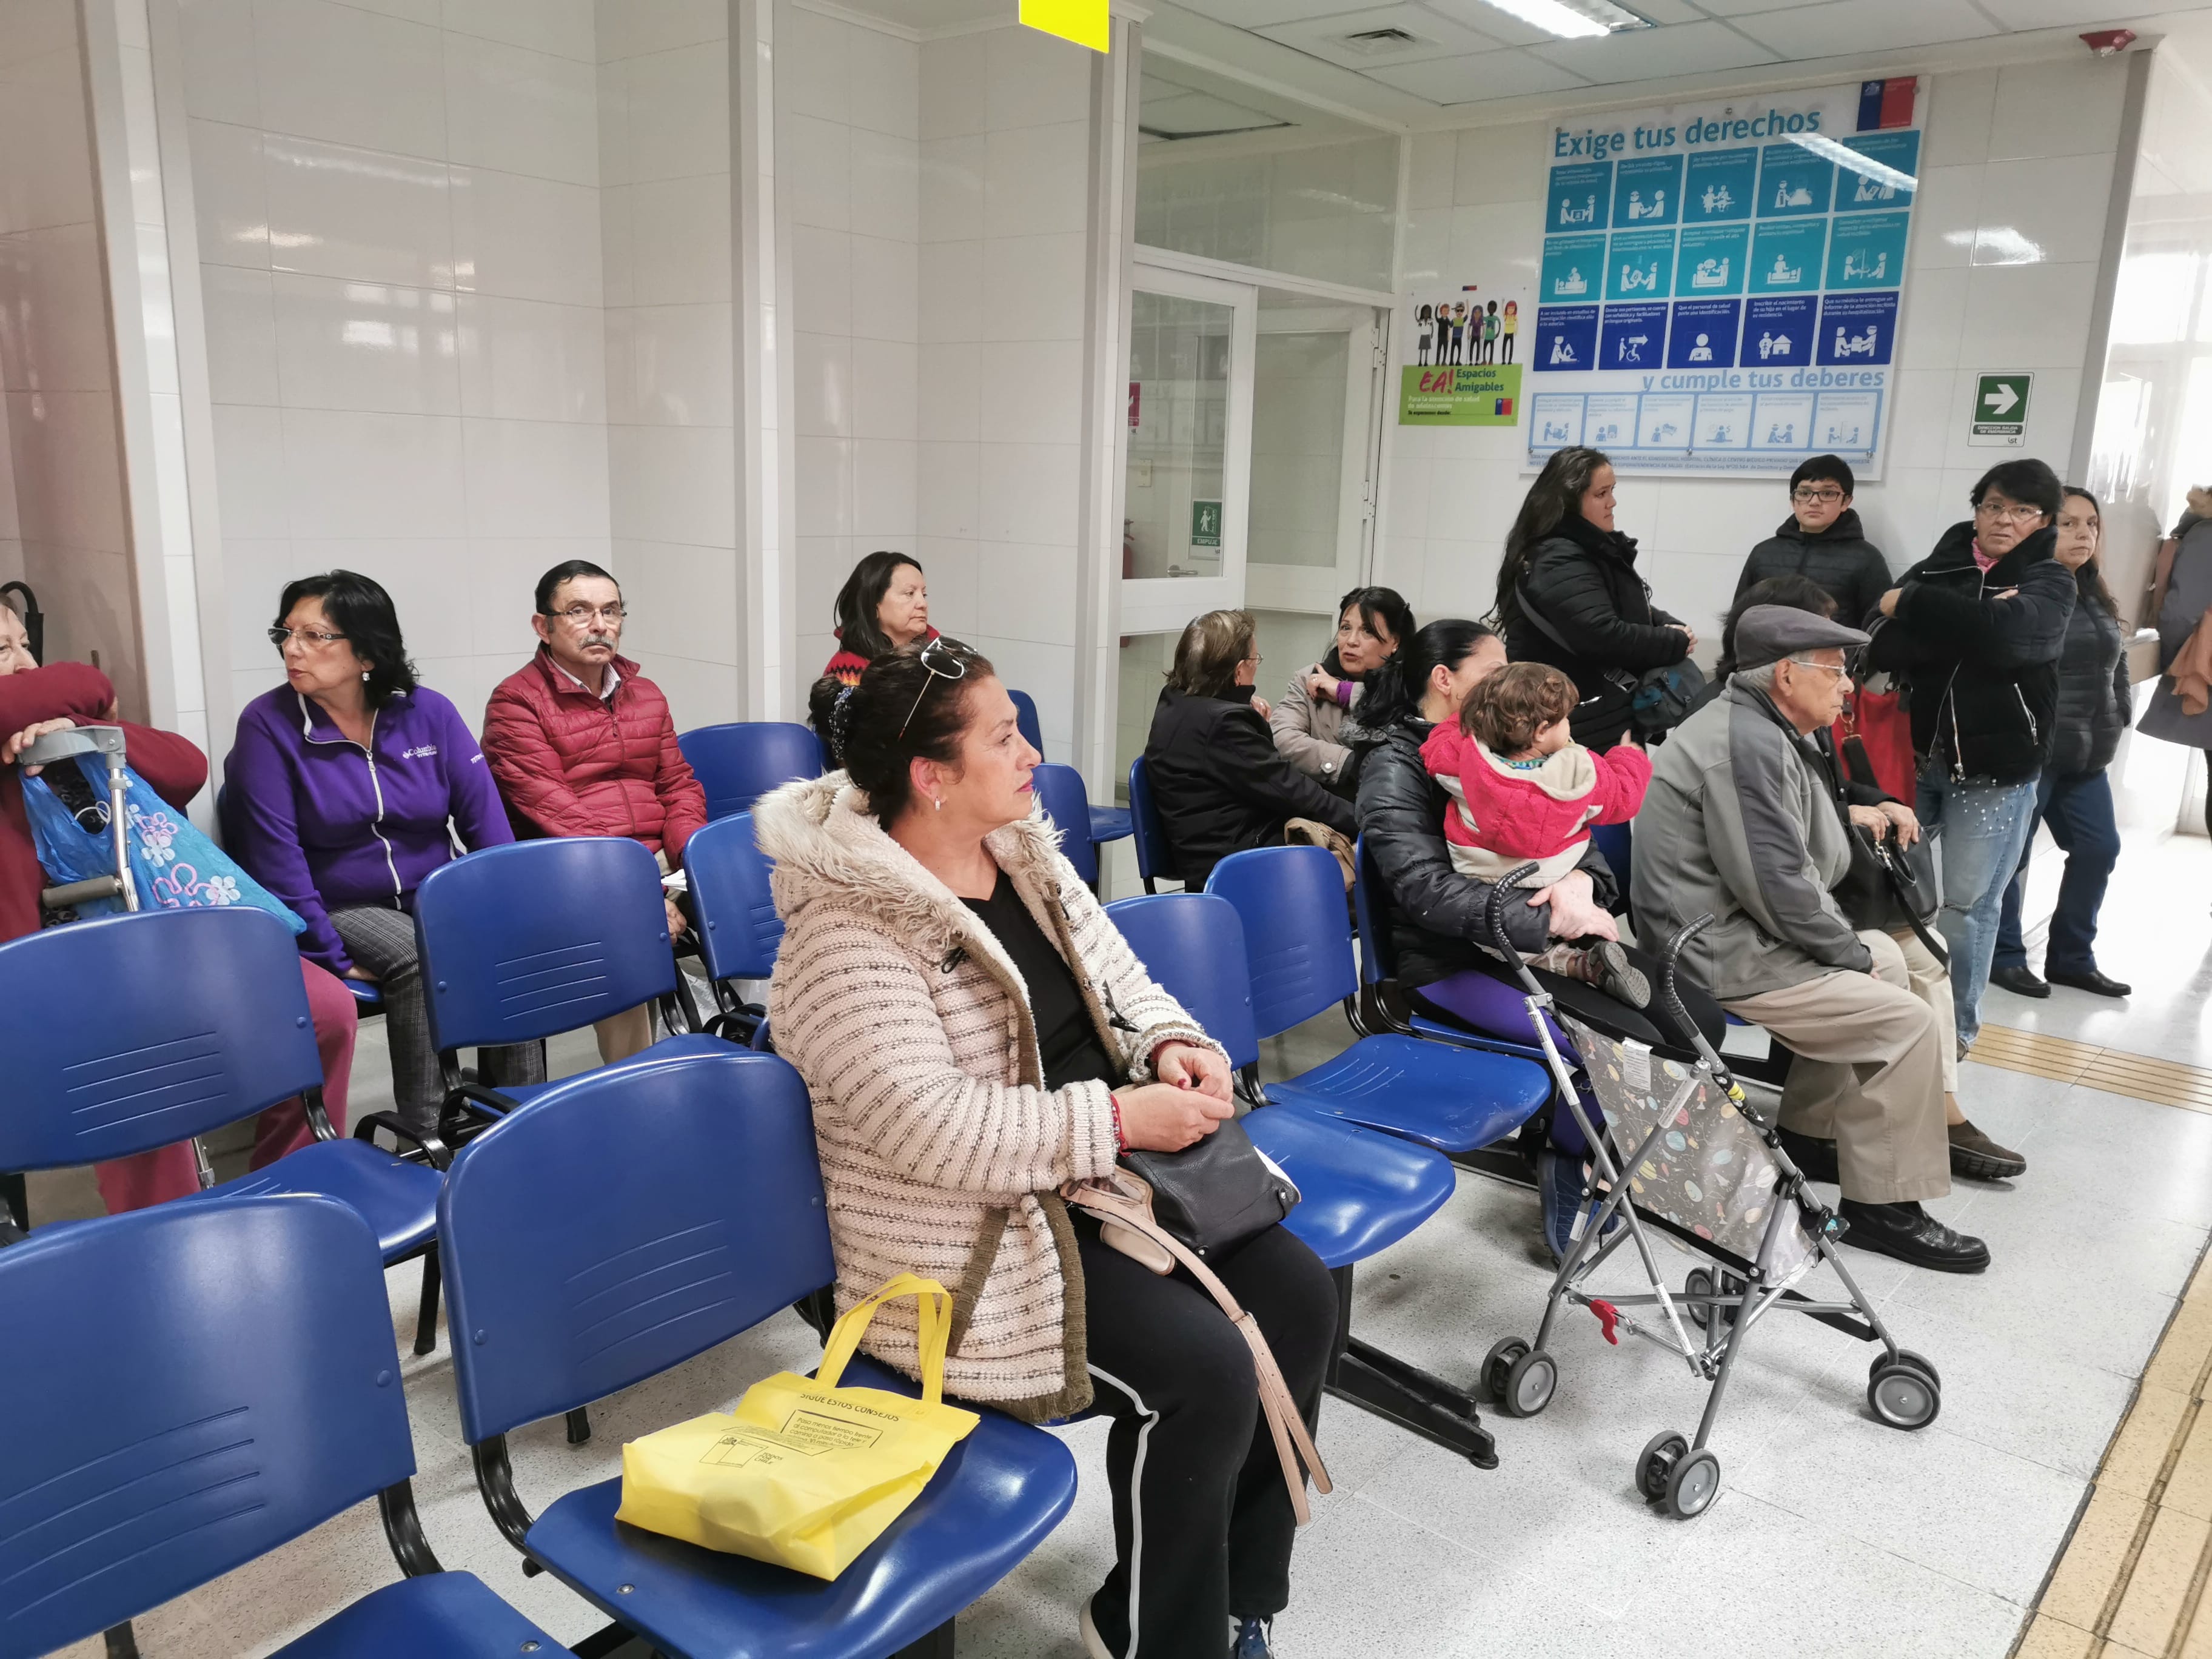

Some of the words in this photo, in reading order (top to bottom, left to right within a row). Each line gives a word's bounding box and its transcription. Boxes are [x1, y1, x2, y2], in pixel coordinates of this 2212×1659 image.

[1555, 126, 1625, 160] Exige
[1634, 126, 1676, 149] tus
[1685, 109, 1821, 145] derechos
[1456, 367, 1496, 380] Espacios
[1642, 375, 1654, 392] y
[1660, 369, 1741, 392] cumple
[1748, 372, 1783, 389] tus
[1790, 367, 1885, 388] deberes
[1455, 382, 1504, 393] Amigables
[408, 743, 437, 756] Columbia
